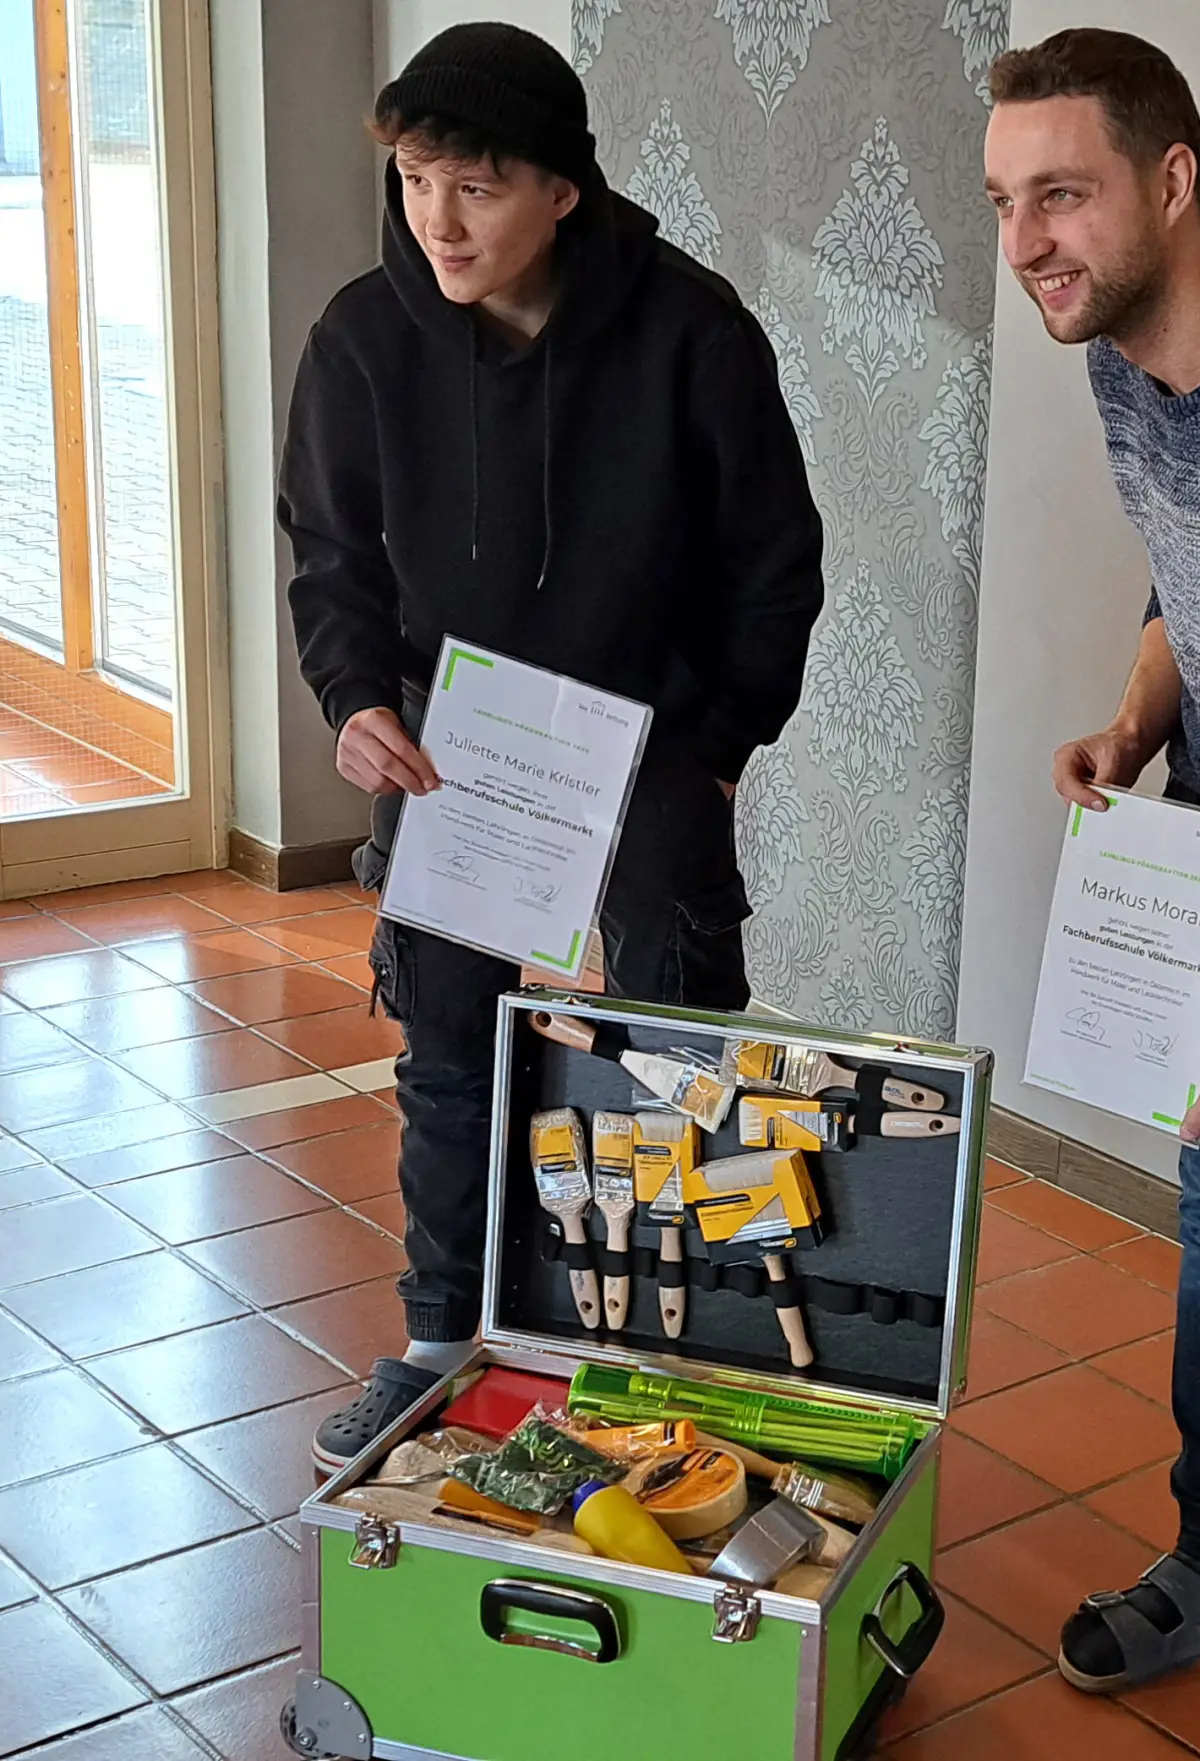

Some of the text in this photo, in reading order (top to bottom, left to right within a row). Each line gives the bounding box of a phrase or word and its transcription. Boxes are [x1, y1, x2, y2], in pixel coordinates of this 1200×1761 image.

[444, 731, 501, 763] Juliette
[504, 755, 545, 779] Marie
[549, 770, 601, 797] Kristler
[438, 777, 593, 838] achberufsschule Völkermarkt
[1081, 877, 1147, 911] Markus
[1062, 925, 1145, 957] Fachberufsschule
